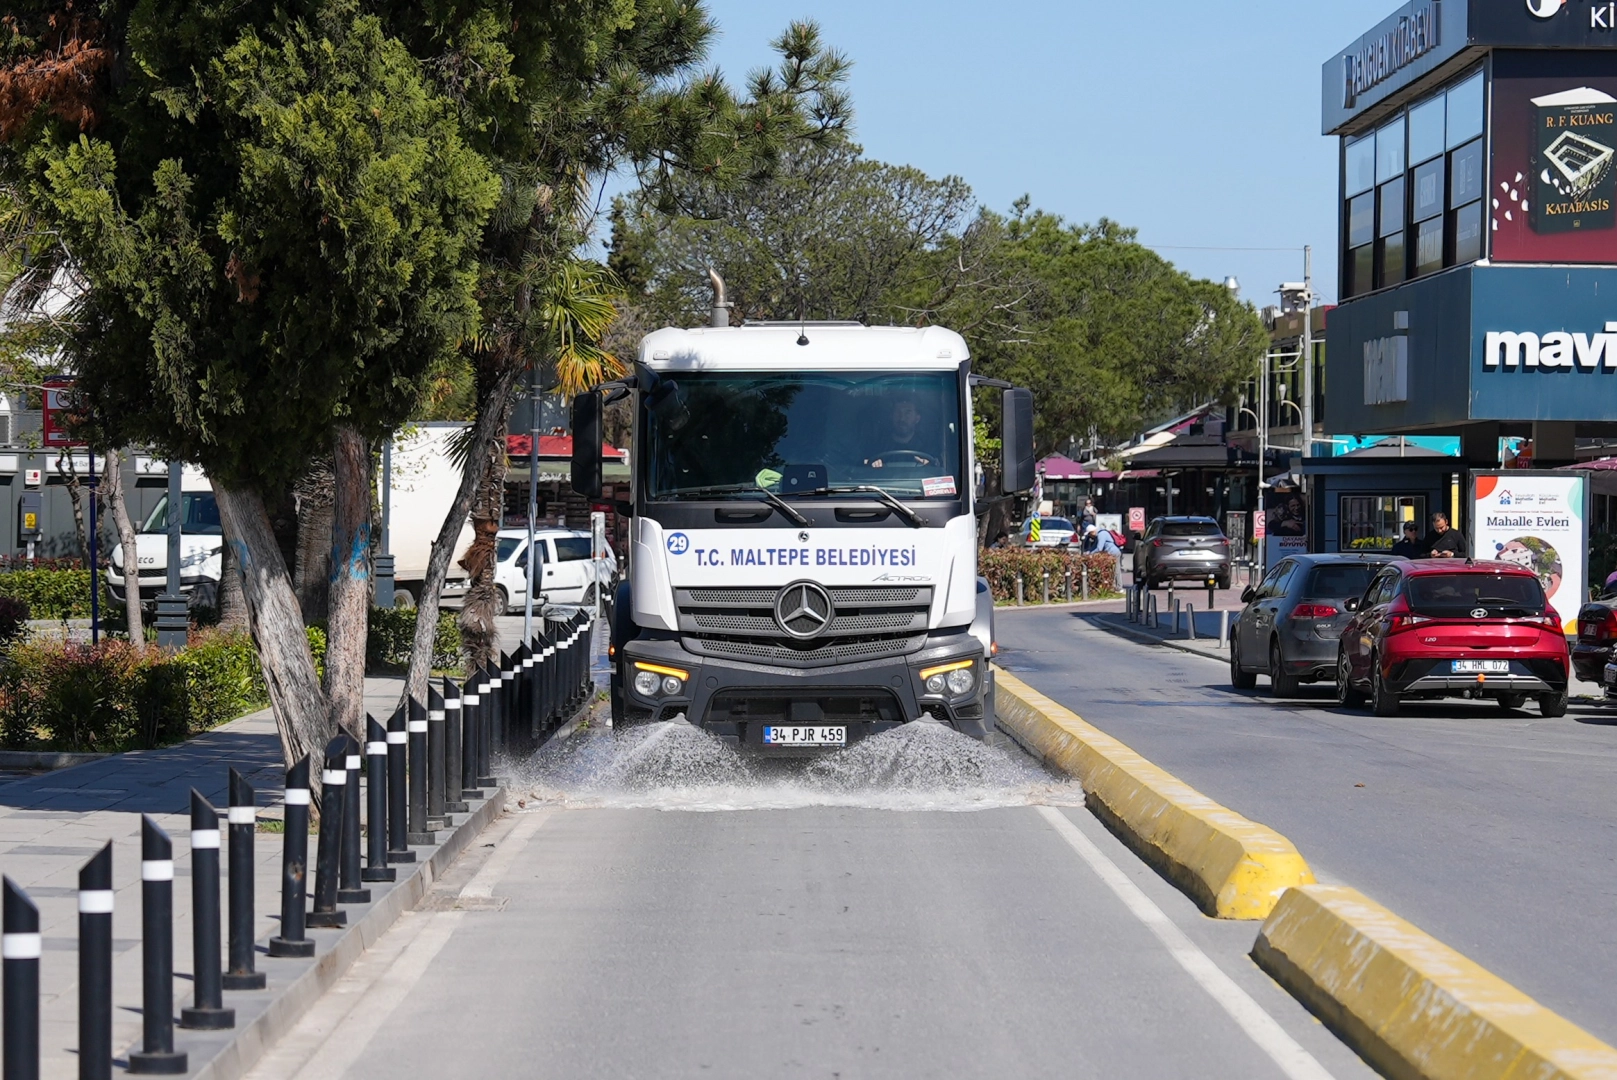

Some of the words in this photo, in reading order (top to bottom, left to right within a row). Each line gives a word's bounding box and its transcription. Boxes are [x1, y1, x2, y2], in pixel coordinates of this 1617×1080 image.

[1352, 32, 1391, 96] PENGUEN
[1546, 116, 1556, 128] R.
[1559, 115, 1567, 127] F.
[1570, 112, 1614, 127] KUANG
[1545, 198, 1610, 215] KATABASİS
[1485, 321, 1617, 367] mavi
[1487, 516, 1533, 526] Mahalle
[1536, 516, 1569, 526] Evleri
[669, 536, 687, 551] 29
[695, 549, 724, 566] T.C.
[731, 549, 809, 566] MALTEPE
[816, 544, 915, 566] BELEDİYESİ
[1457, 661, 1467, 670] 34
[1472, 661, 1487, 670] HML
[1492, 661, 1508, 670] 072
[771, 728, 786, 741] 34
[792, 728, 815, 741] PJR
[821, 728, 843, 741] 459
